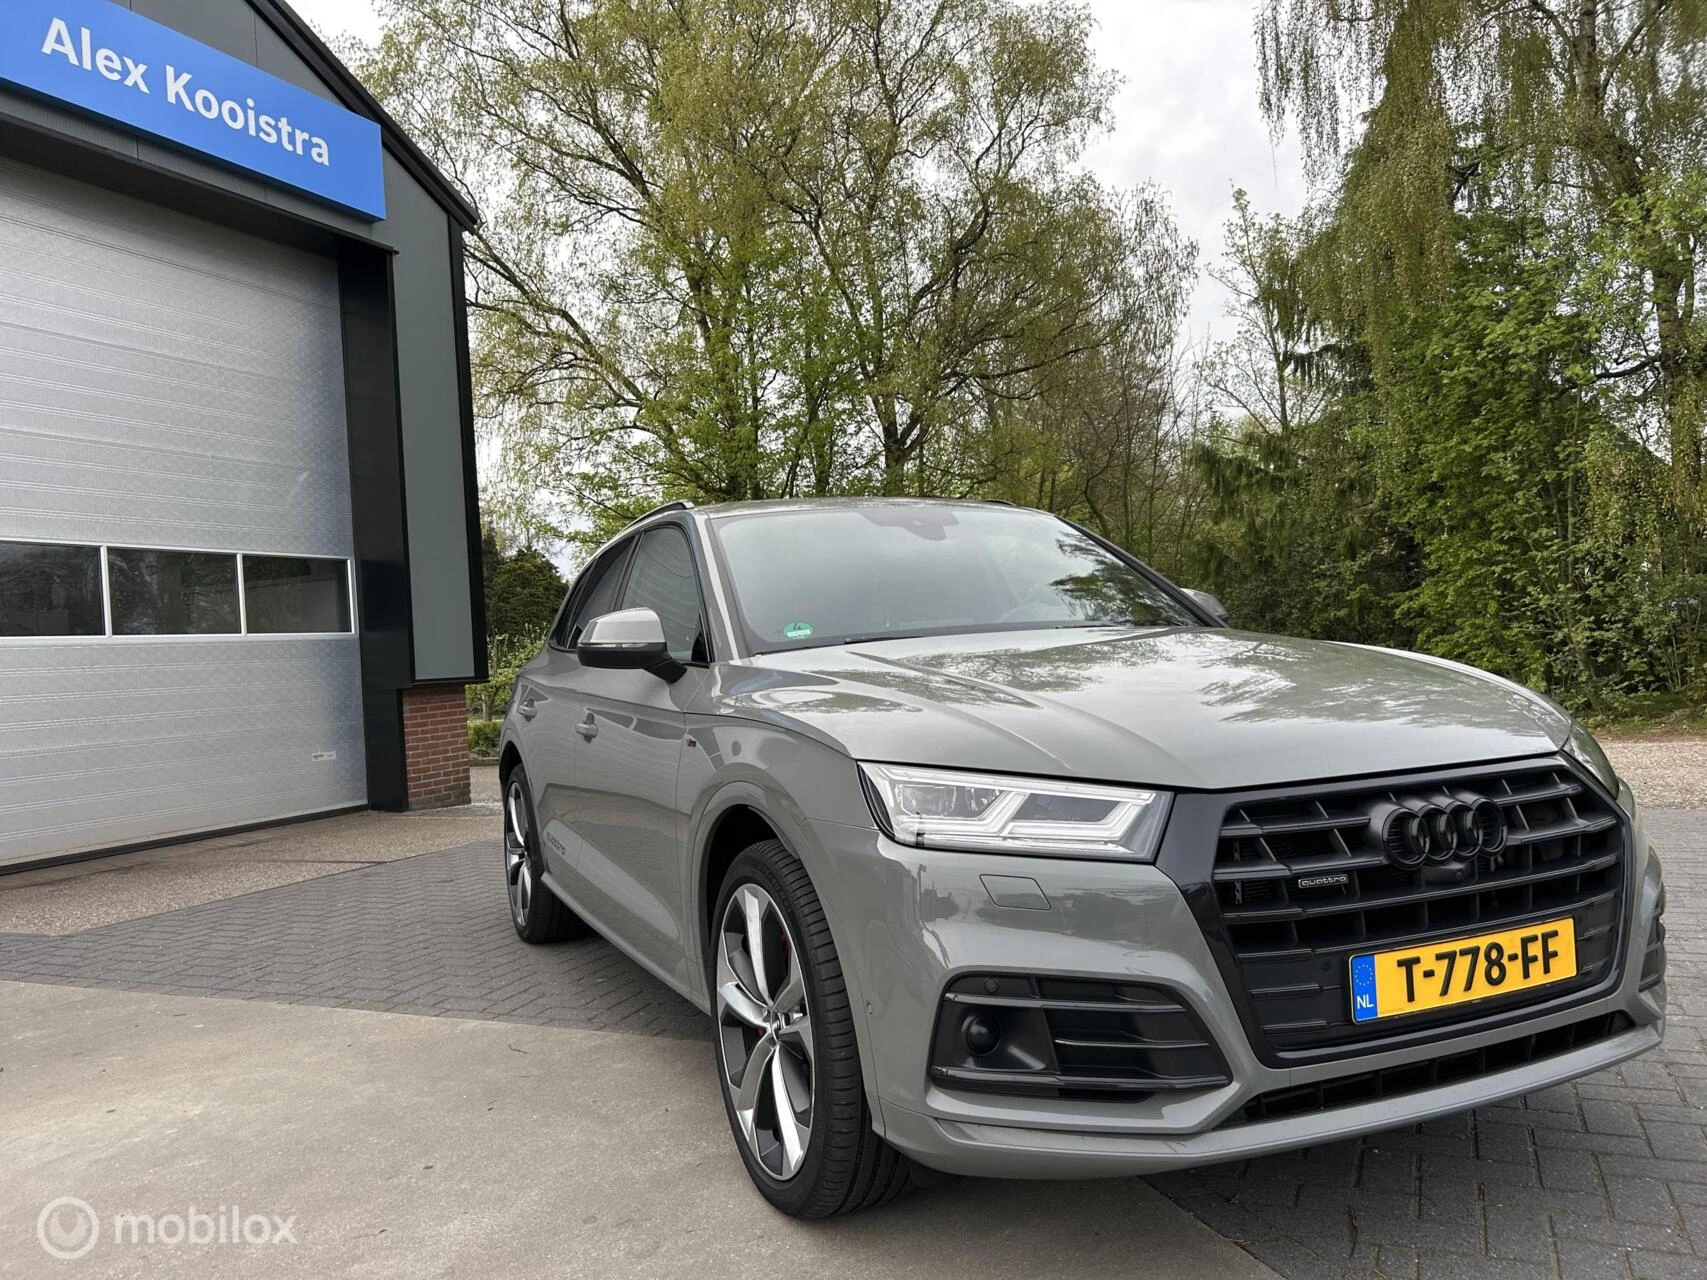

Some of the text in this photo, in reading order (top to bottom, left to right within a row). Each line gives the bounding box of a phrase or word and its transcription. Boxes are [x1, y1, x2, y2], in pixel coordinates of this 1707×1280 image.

[41, 17, 330, 166] Alex Kooistra
[1301, 876, 1347, 887] quattro
[1396, 929, 1559, 1003] T-778-FF
[1356, 994, 1374, 1009] NL
